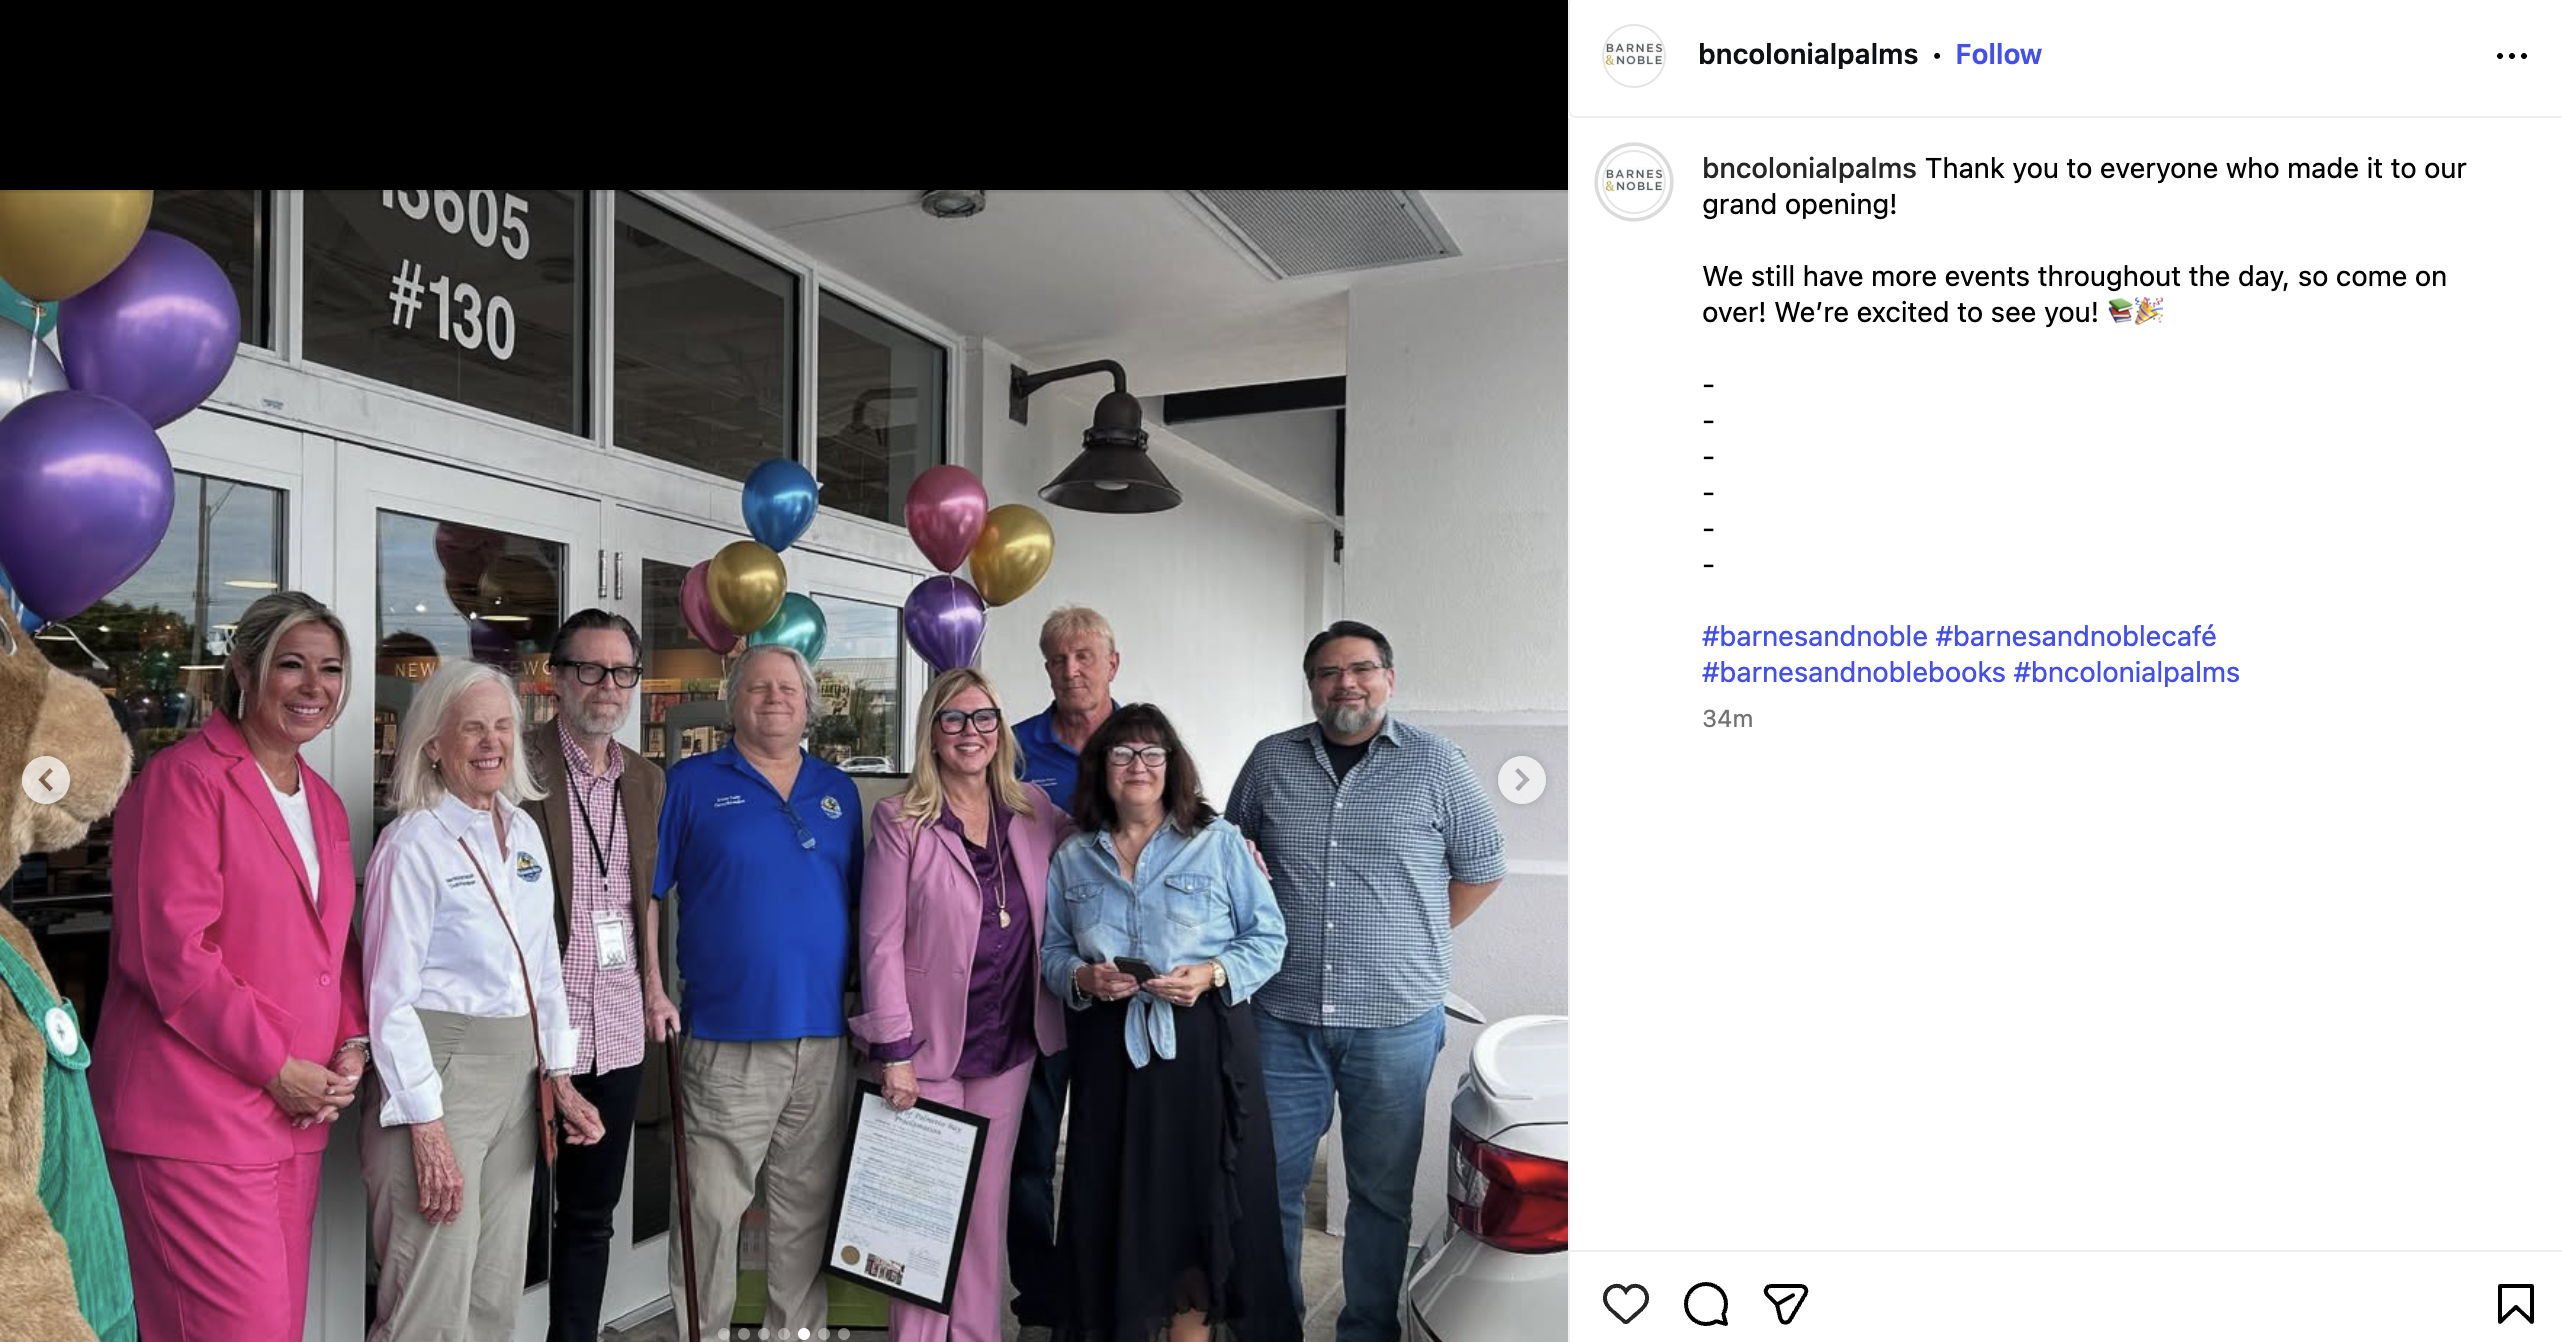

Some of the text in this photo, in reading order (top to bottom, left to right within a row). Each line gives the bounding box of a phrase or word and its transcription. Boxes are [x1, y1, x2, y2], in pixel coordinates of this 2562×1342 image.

[382, 190, 530, 260] 605
[389, 259, 515, 360] #130
[395, 662, 435, 678] NEW
